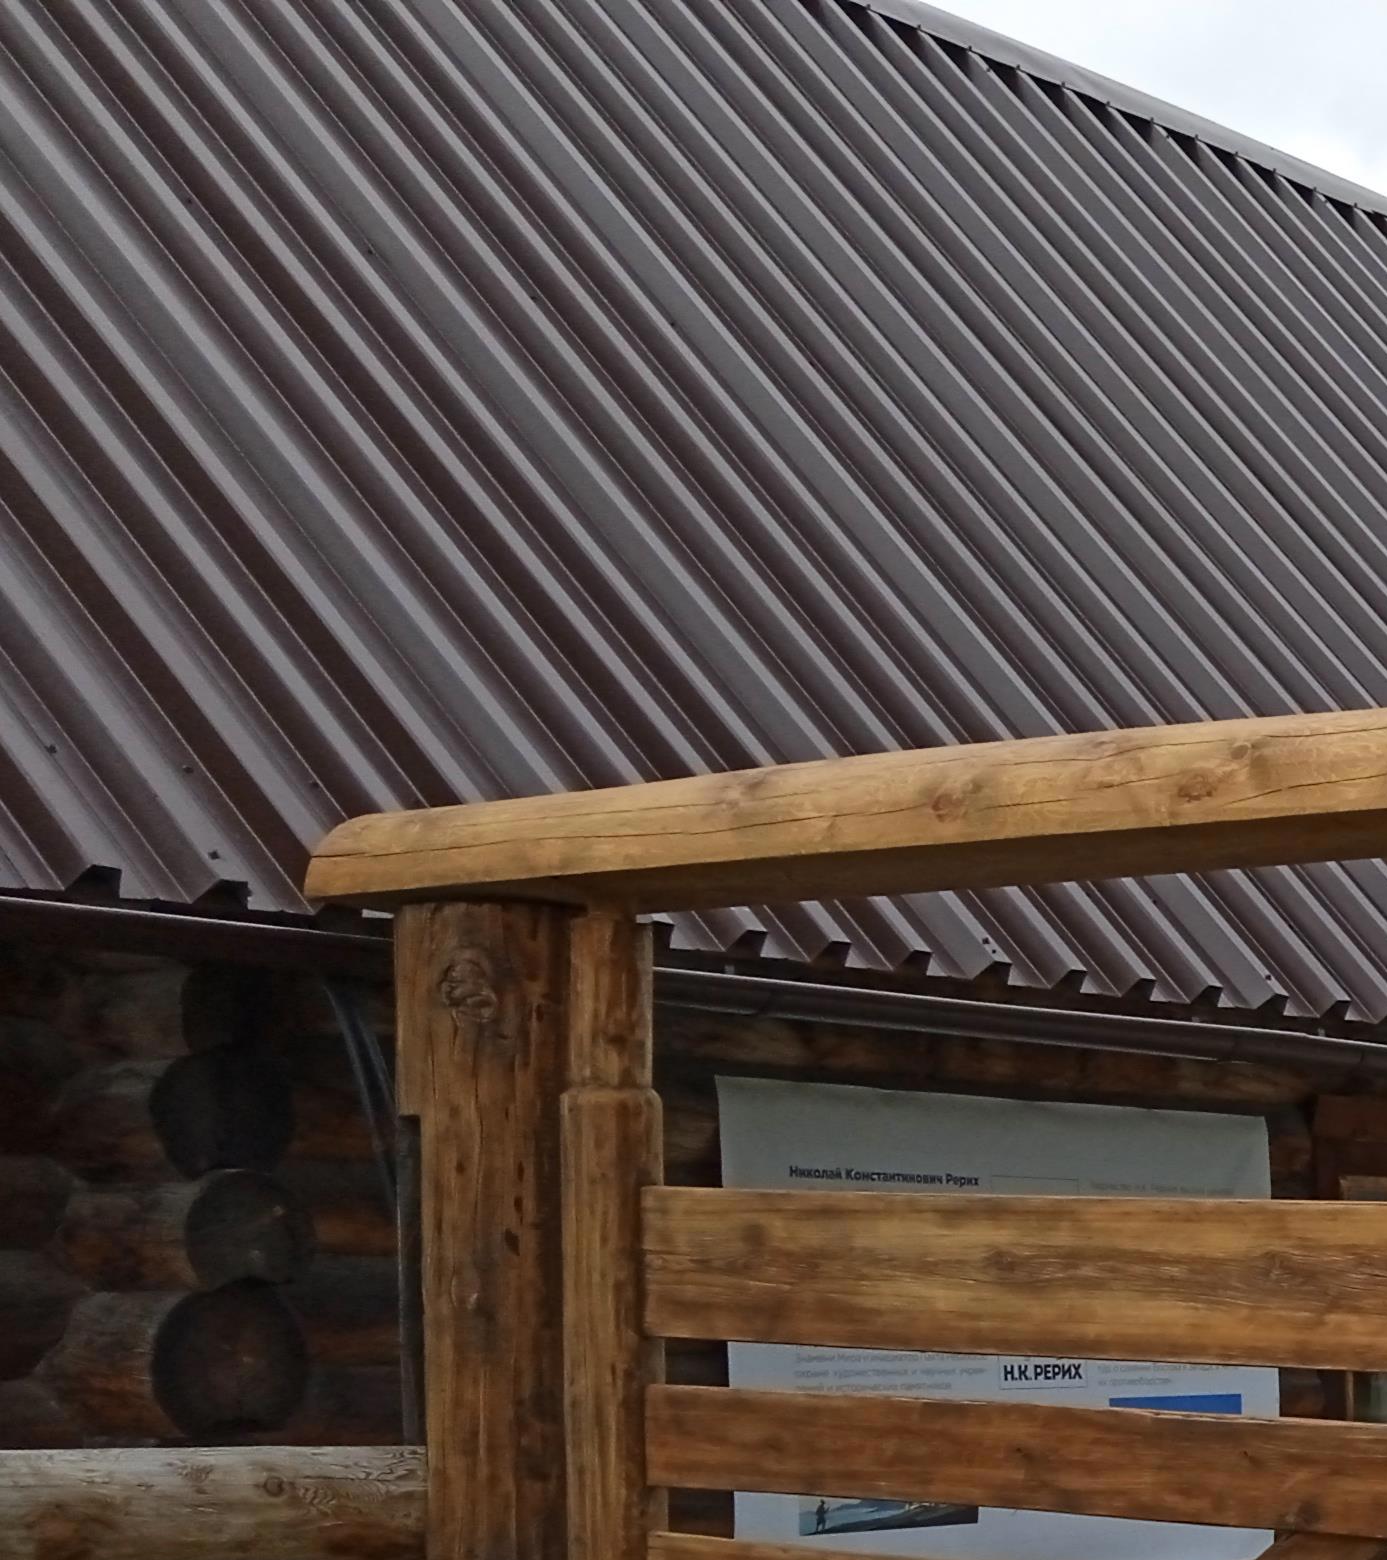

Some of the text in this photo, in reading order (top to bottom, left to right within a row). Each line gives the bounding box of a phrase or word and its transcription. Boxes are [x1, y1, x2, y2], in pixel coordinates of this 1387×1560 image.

[789, 1165, 980, 1188] Николай Константинович Рерих
[1003, 1364, 1033, 1382] Н.К.
[1034, 1363, 1083, 1381] РЕРИХ
